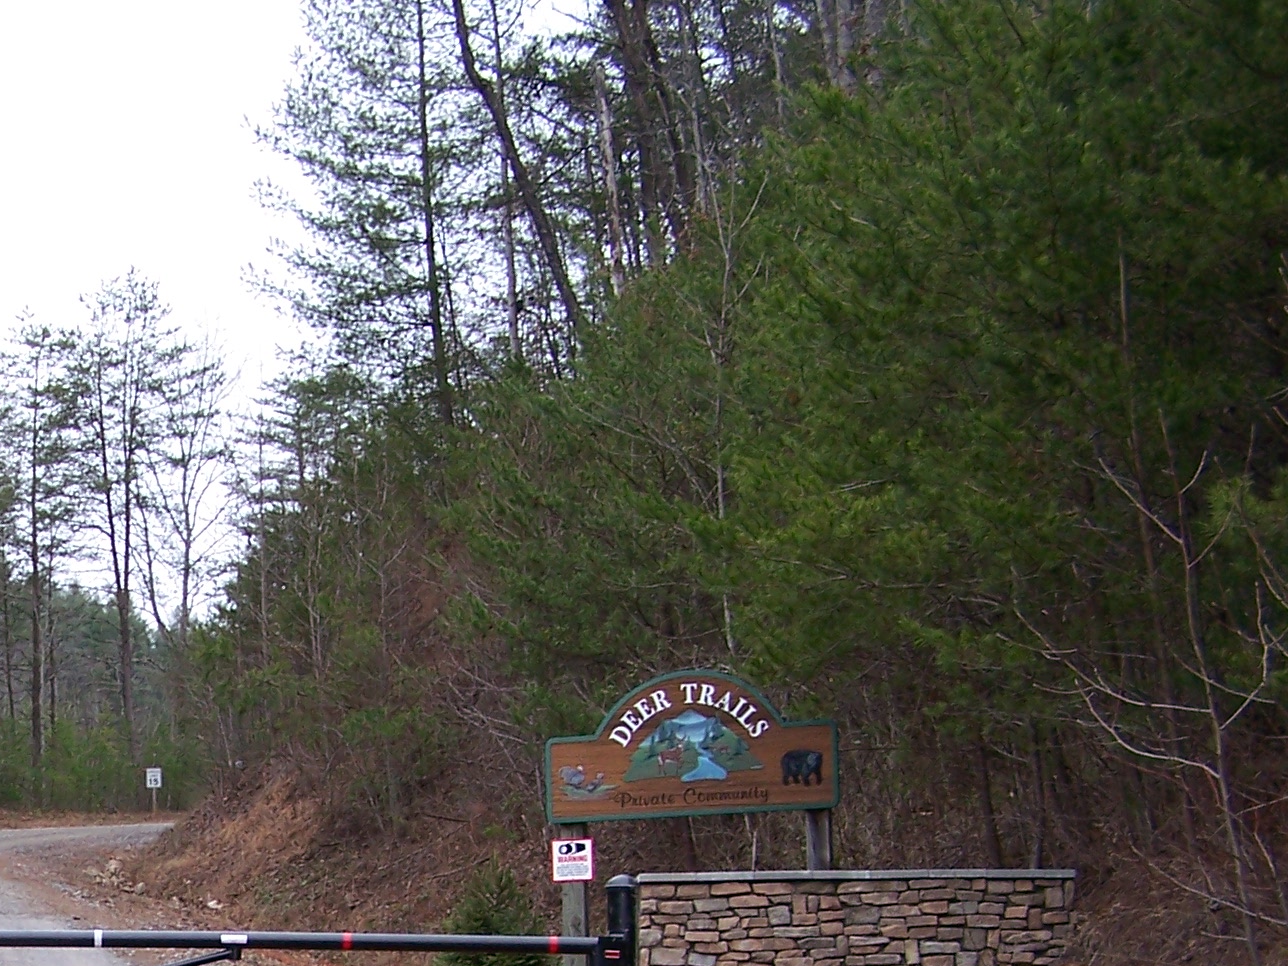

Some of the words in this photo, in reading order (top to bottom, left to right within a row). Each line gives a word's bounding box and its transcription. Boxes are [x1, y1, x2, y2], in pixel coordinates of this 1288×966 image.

[608, 689, 672, 748] DEER
[680, 683, 770, 738] TRAILS
[149, 778, 159, 786] 15
[615, 792, 677, 808] Private
[683, 786, 770, 804] Community
[557, 855, 588, 863] WARNING
